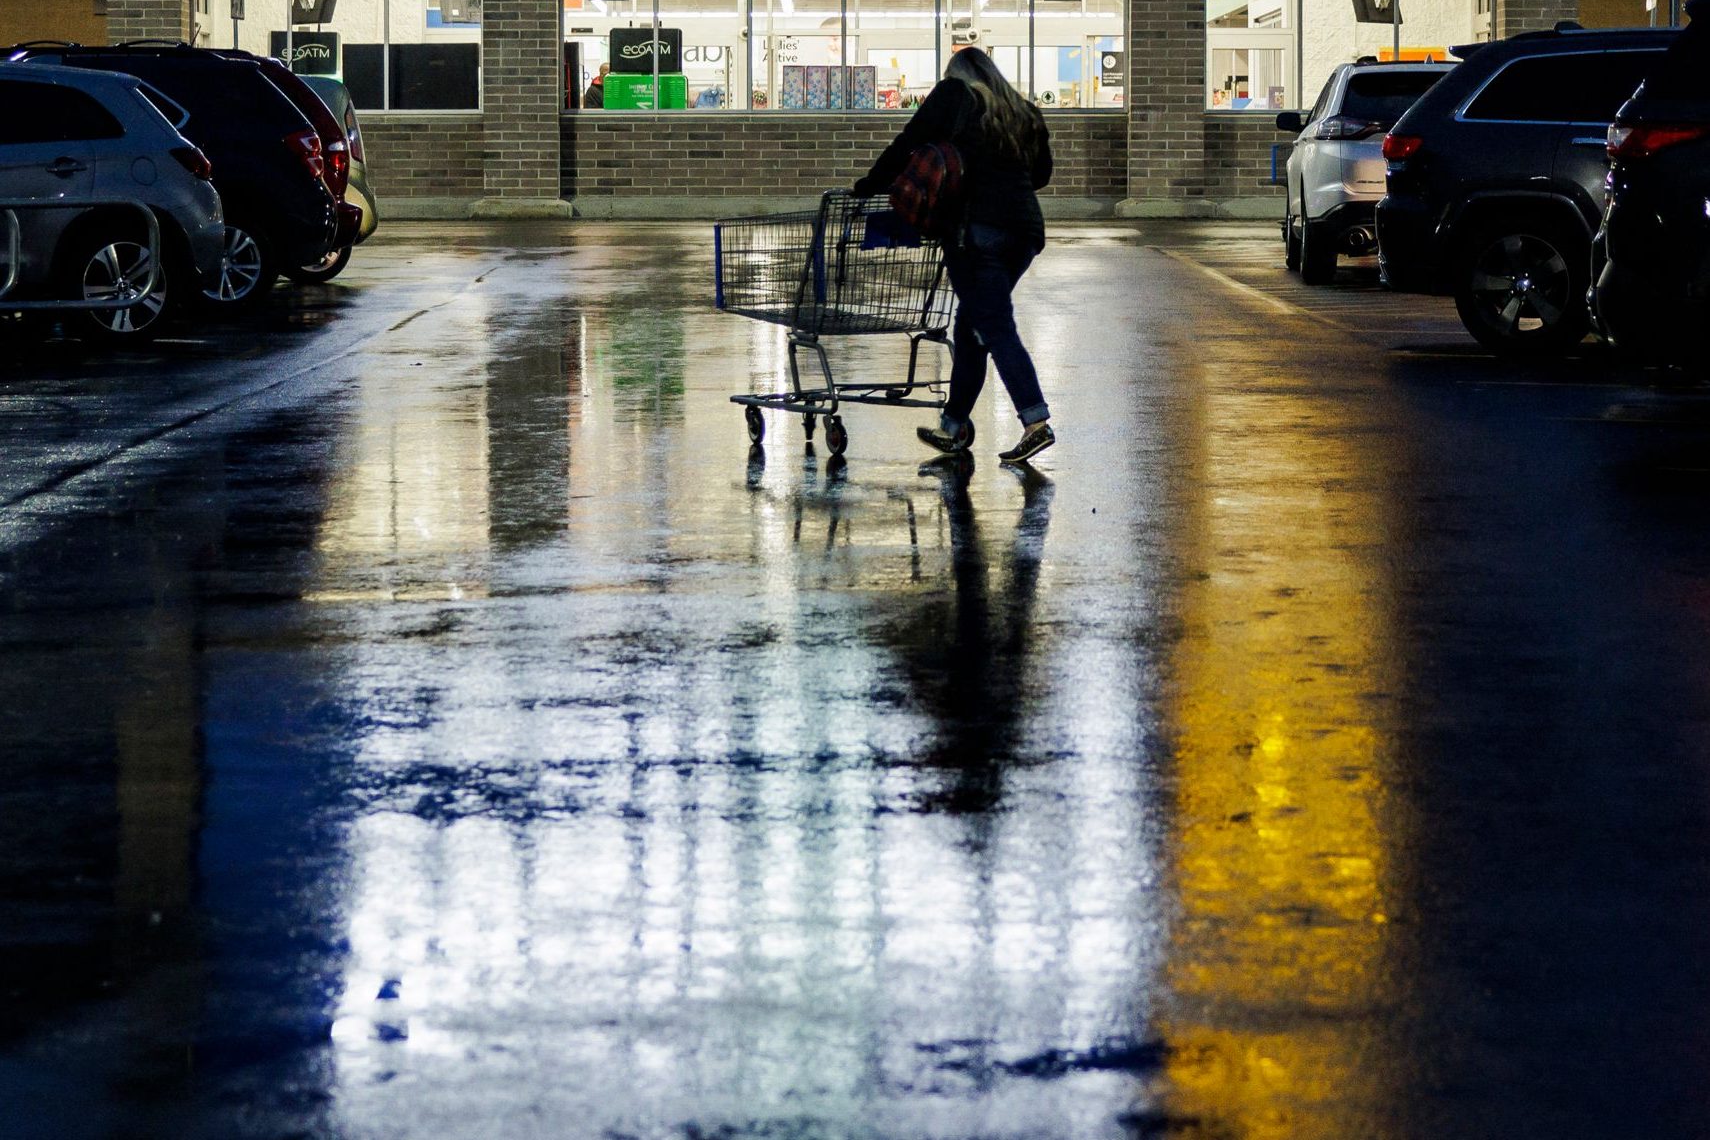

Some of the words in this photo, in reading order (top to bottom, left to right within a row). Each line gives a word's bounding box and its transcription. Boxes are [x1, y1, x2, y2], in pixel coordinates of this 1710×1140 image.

[623, 45, 671, 55] ecoAM
[763, 40, 799, 50] Ldies'
[762, 53, 798, 63] Ative
